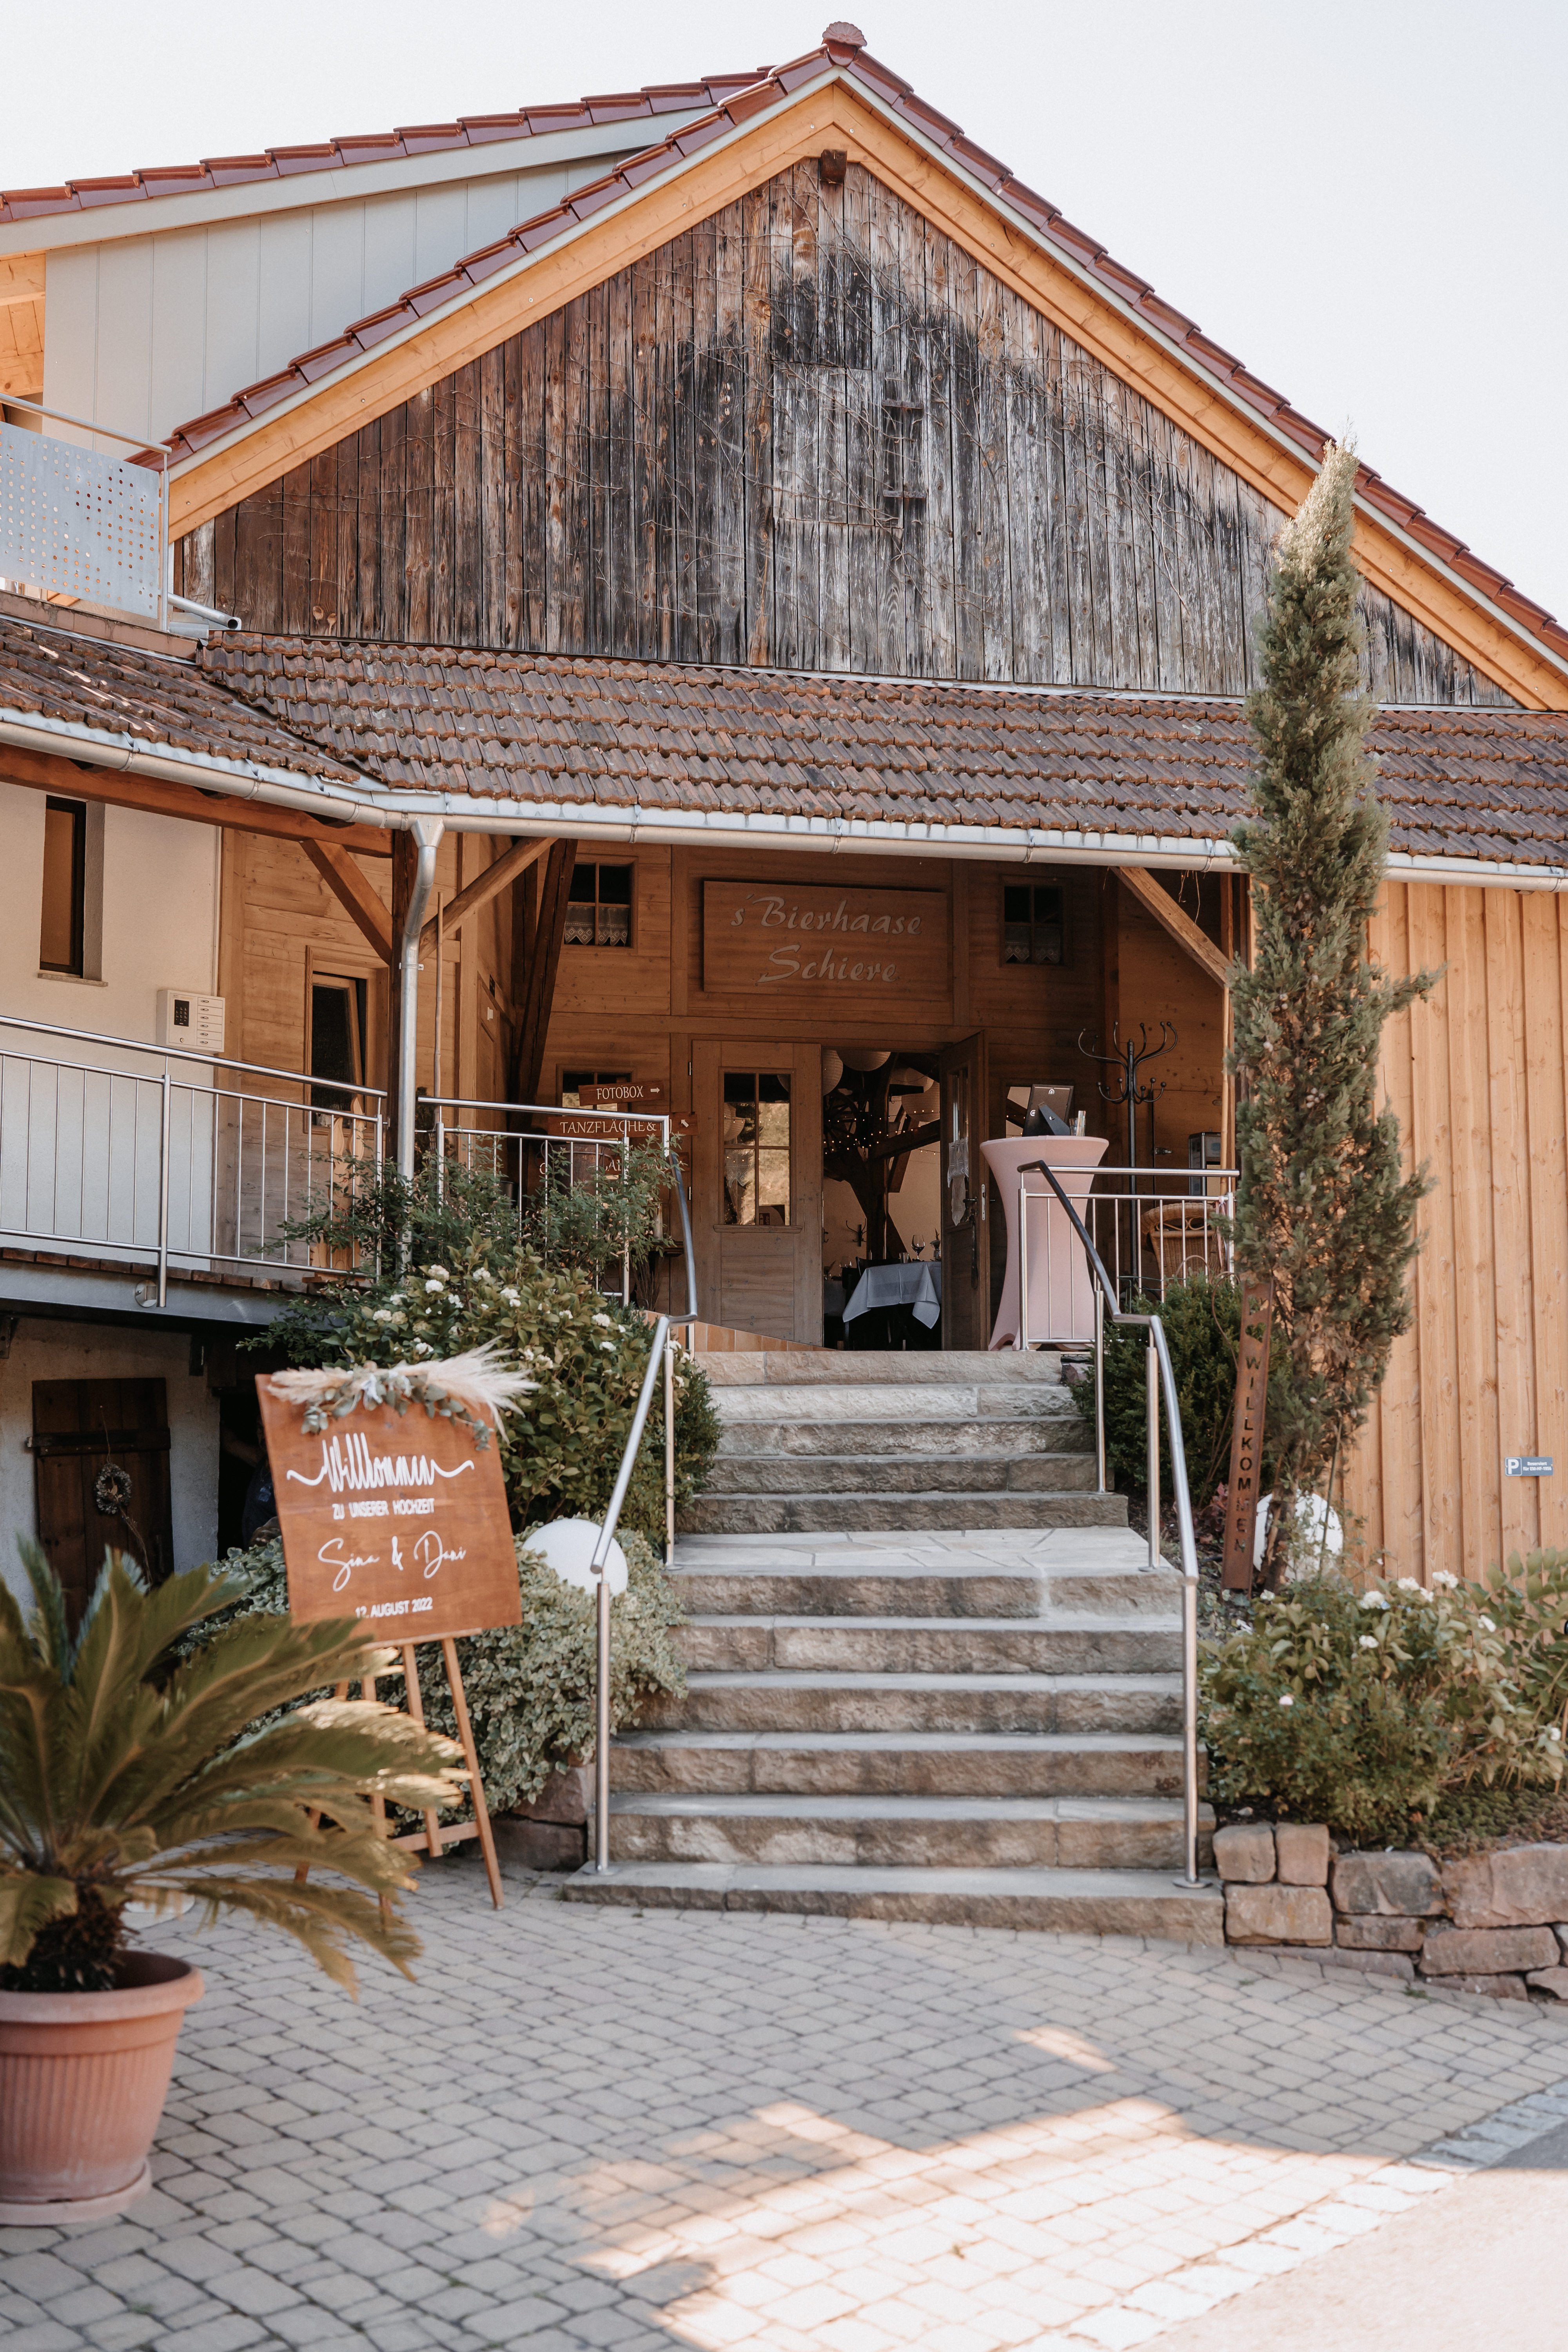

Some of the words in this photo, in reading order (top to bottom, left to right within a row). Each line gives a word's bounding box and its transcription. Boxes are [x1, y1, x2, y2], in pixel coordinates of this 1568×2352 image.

[757, 944, 898, 983] Schiere
[596, 1085, 644, 1100] FOTOBOX
[560, 1119, 645, 1134] TANZFLÄCHE
[647, 1122, 657, 1131] &
[1234, 1356, 1261, 1553] WILLKOMMEN
[332, 1503, 345, 1519] ZU
[348, 1500, 389, 1518] UNSERER
[392, 1498, 435, 1515] HOCHZEIT
[318, 1537, 380, 1592] Sina
[414, 1530, 466, 1579] Dani
[370, 1600, 410, 1618] AUGUST
[412, 1596, 433, 1613] 2022
